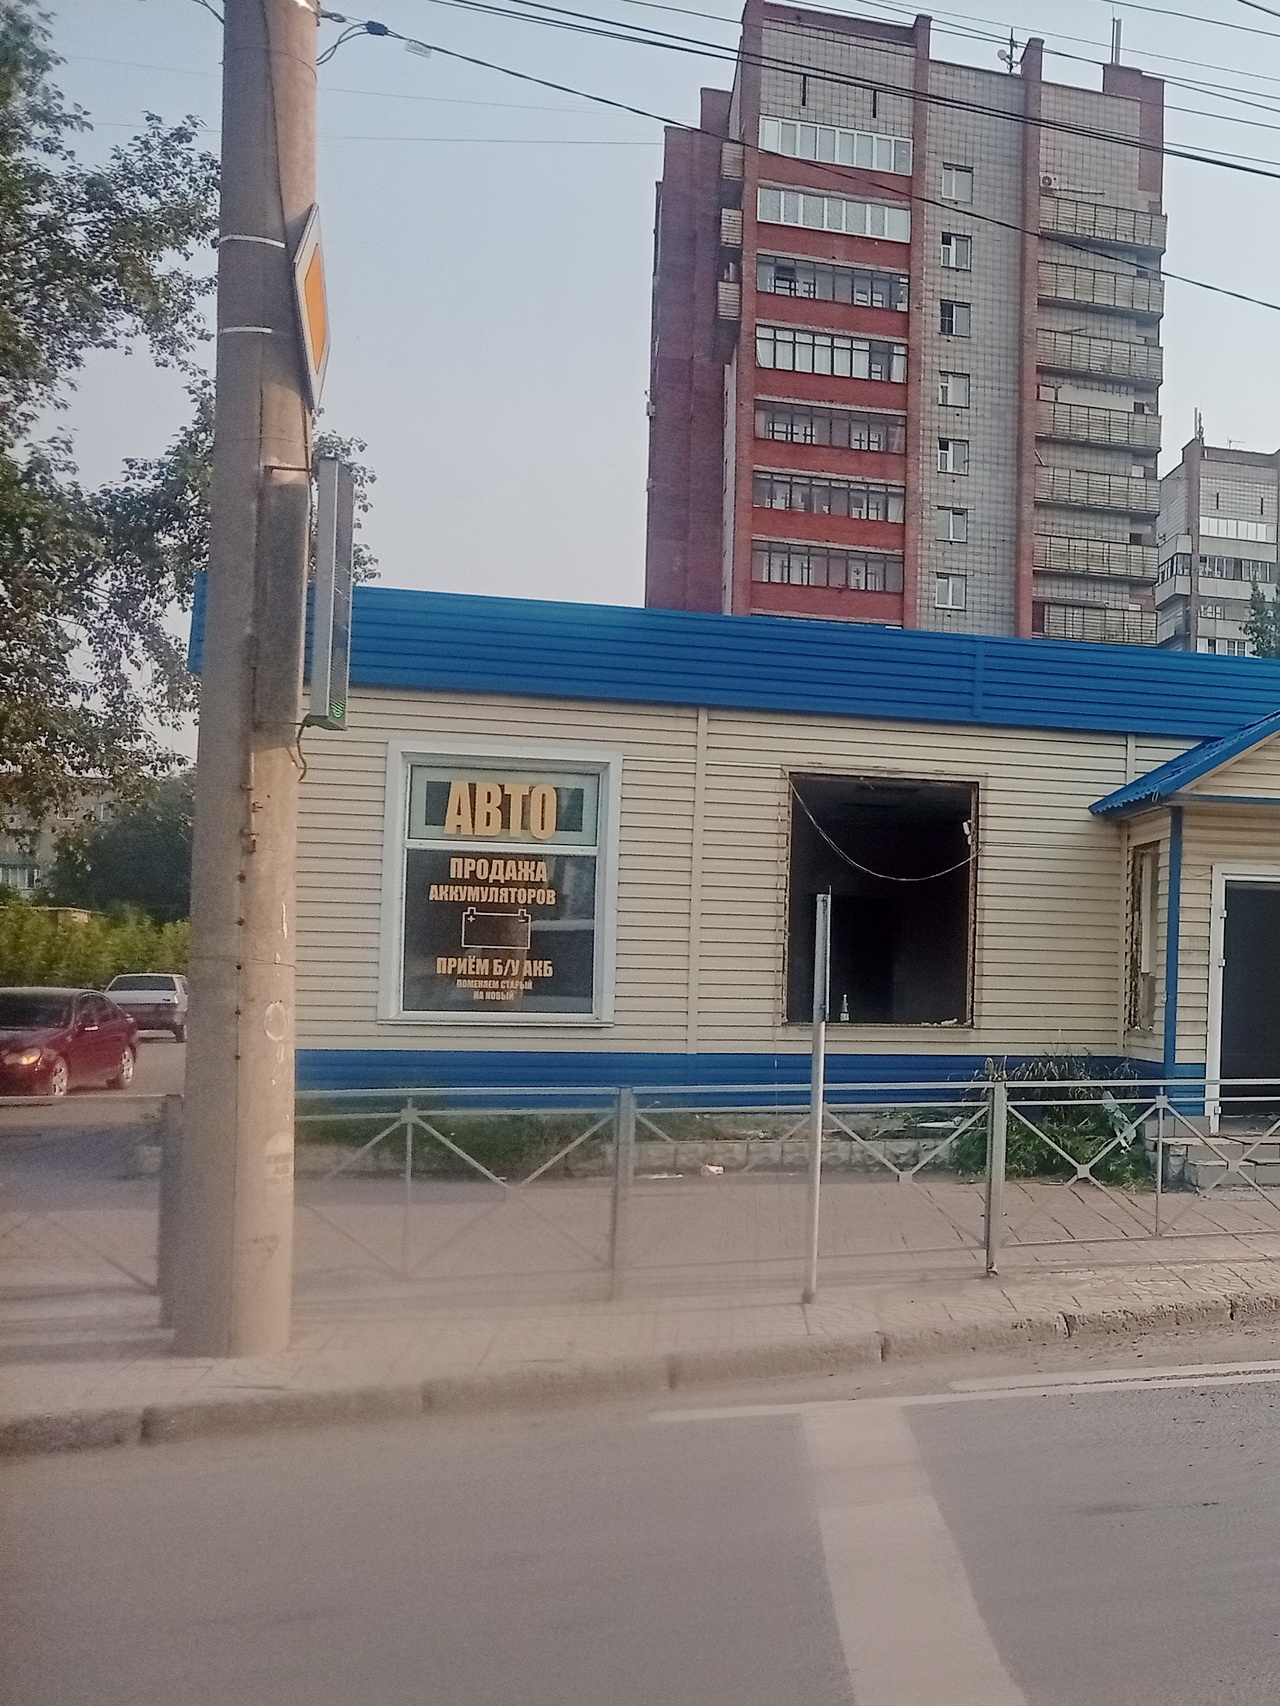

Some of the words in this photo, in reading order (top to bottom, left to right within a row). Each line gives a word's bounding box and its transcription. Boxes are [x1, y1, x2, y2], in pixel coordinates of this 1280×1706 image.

[444, 780, 557, 840] АВТО
[450, 857, 548, 884] ПРОДАЖА
[429, 884, 556, 905] АККУМУЛЯТОРОВ
[436, 955, 490, 976] ПРИЁМ
[493, 959, 520, 976] Б/У
[522, 960, 554, 977] АКБ
[456, 979, 499, 989] ПОМЕНЯЕМ
[500, 980, 533, 990] СТАРЫЙ
[473, 991, 484, 1000] НА
[485, 991, 514, 1000] НОВЫЙ
